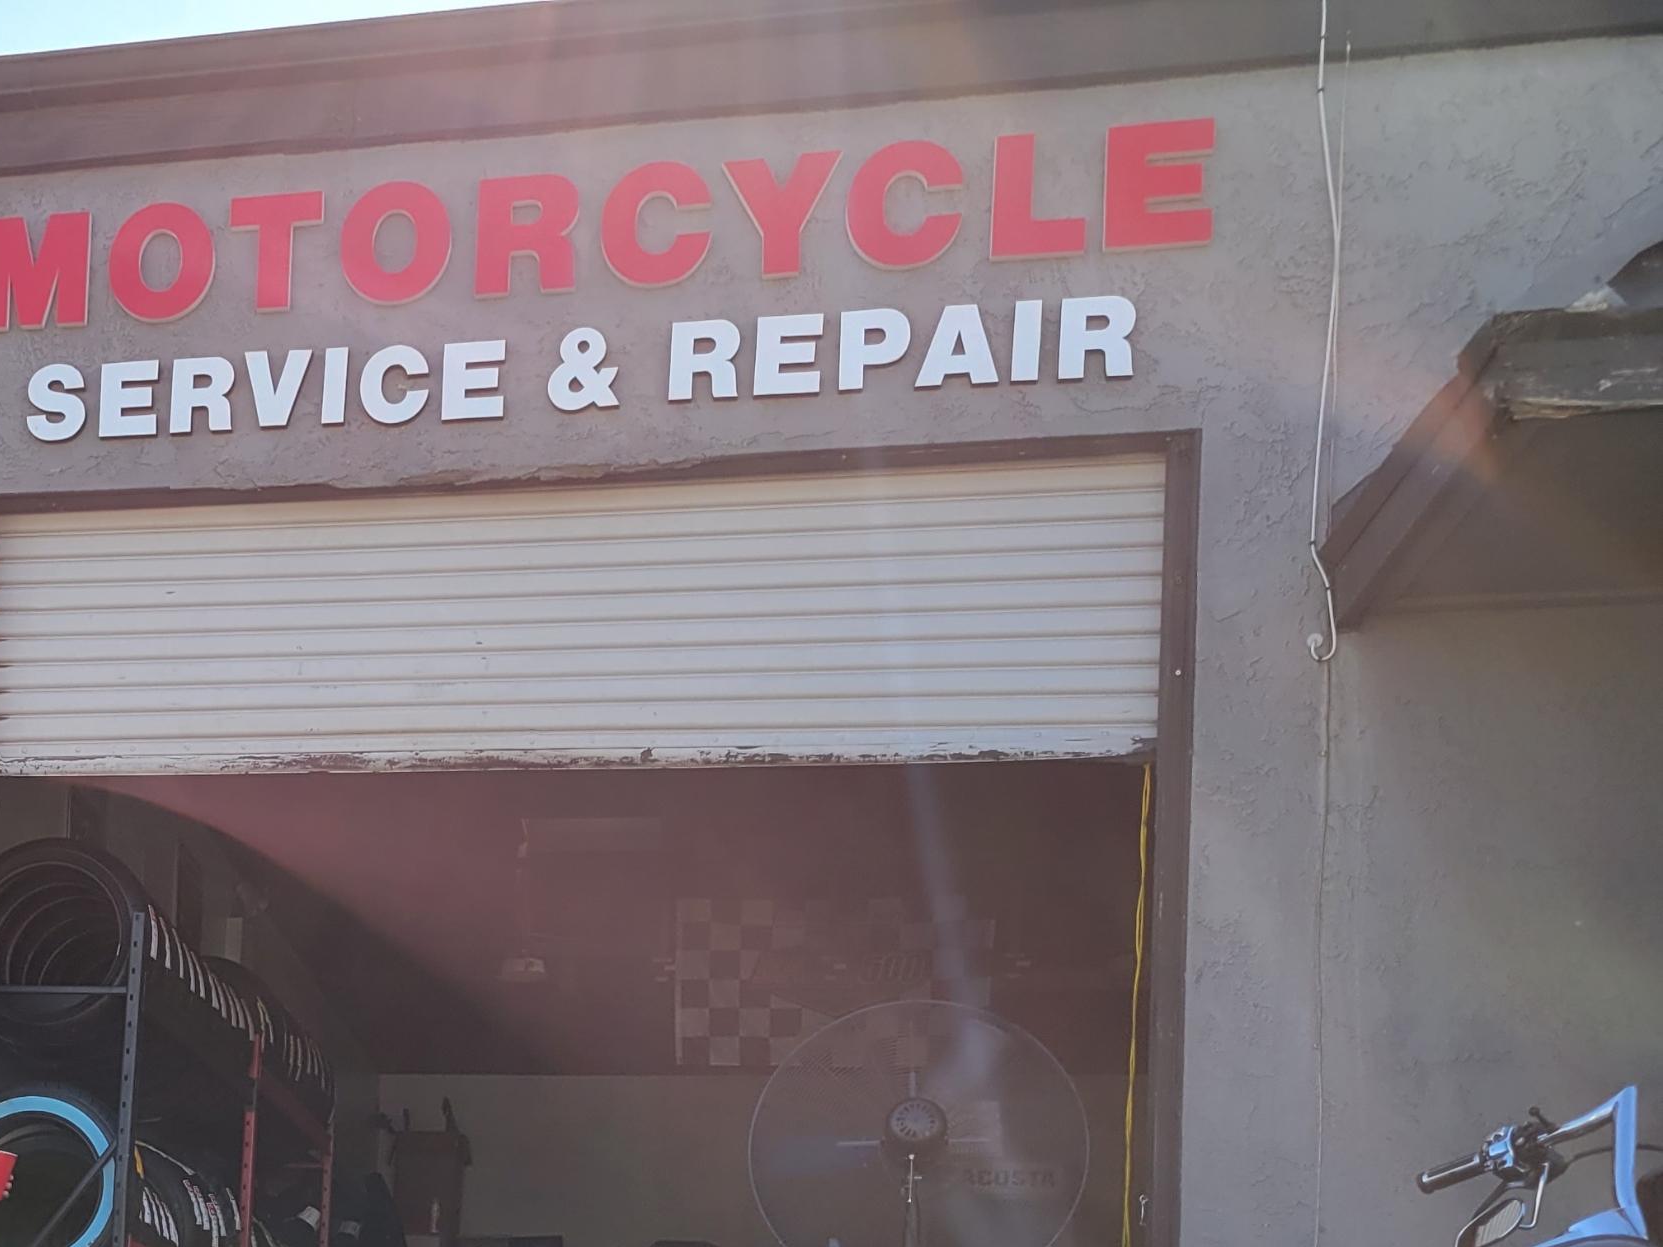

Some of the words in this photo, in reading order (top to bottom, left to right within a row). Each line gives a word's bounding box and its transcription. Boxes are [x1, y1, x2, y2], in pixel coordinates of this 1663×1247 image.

[27, 340, 507, 442] SERVICE
[546, 327, 619, 410] &
[669, 296, 1138, 402] REPAIR
